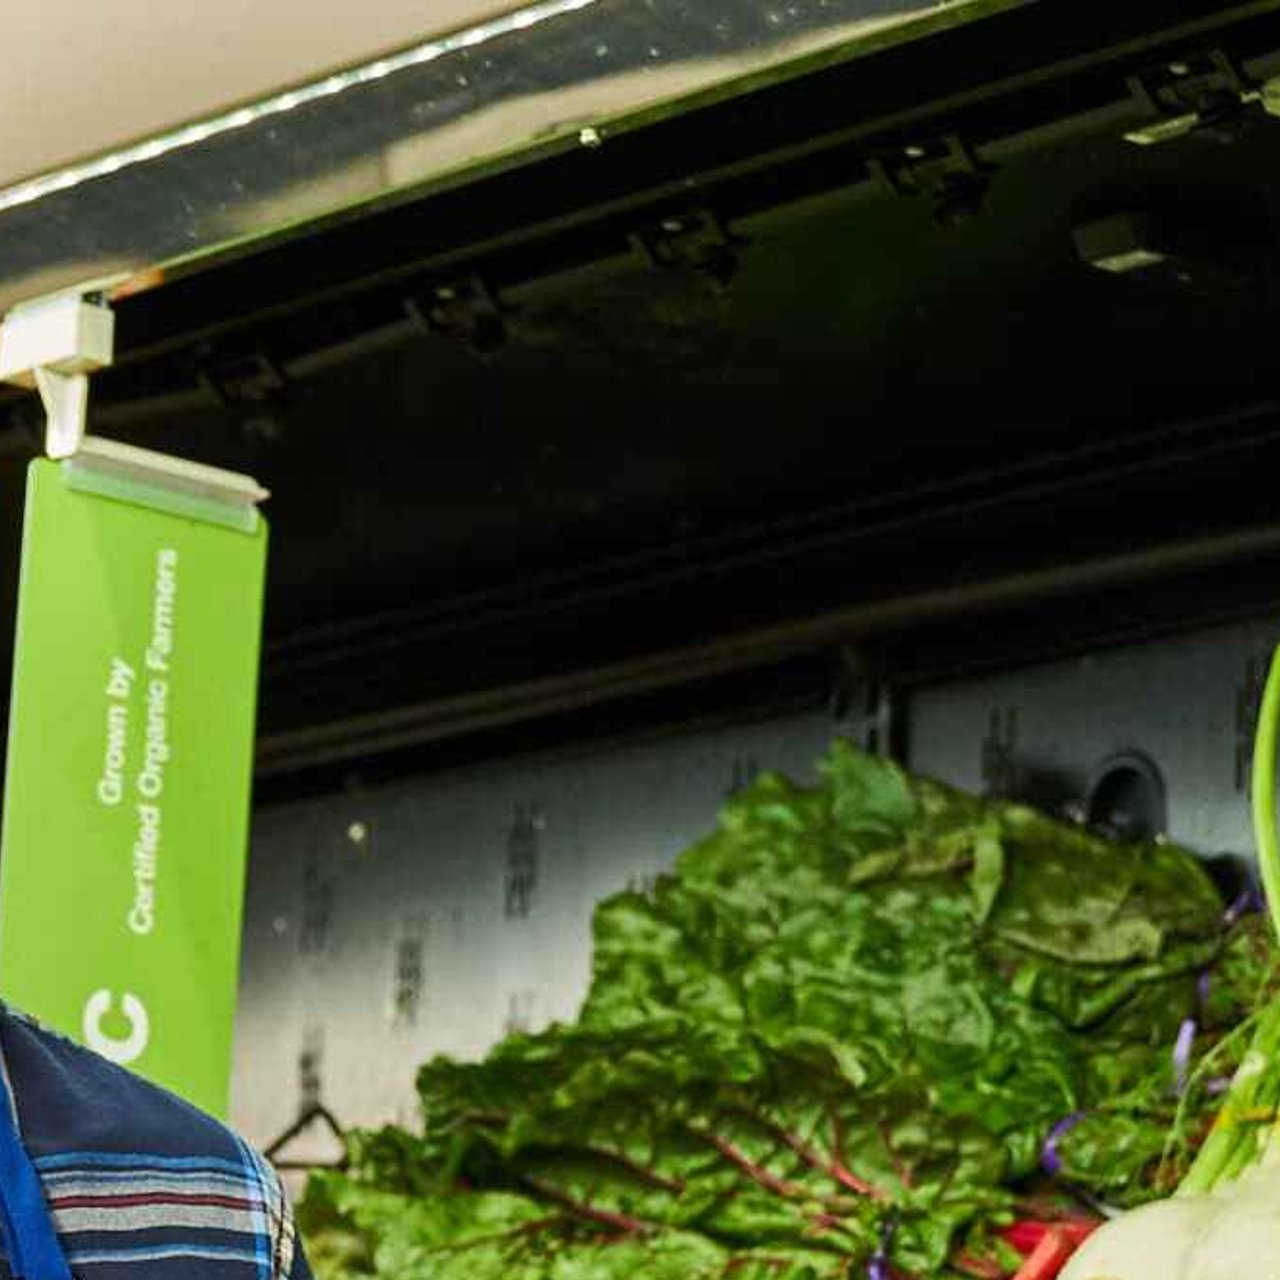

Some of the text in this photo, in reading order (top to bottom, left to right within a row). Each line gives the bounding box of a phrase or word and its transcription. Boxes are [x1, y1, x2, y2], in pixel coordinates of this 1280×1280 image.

[98, 657, 136, 804] Grown by
[127, 548, 178, 935] Certified Organic Farmers
